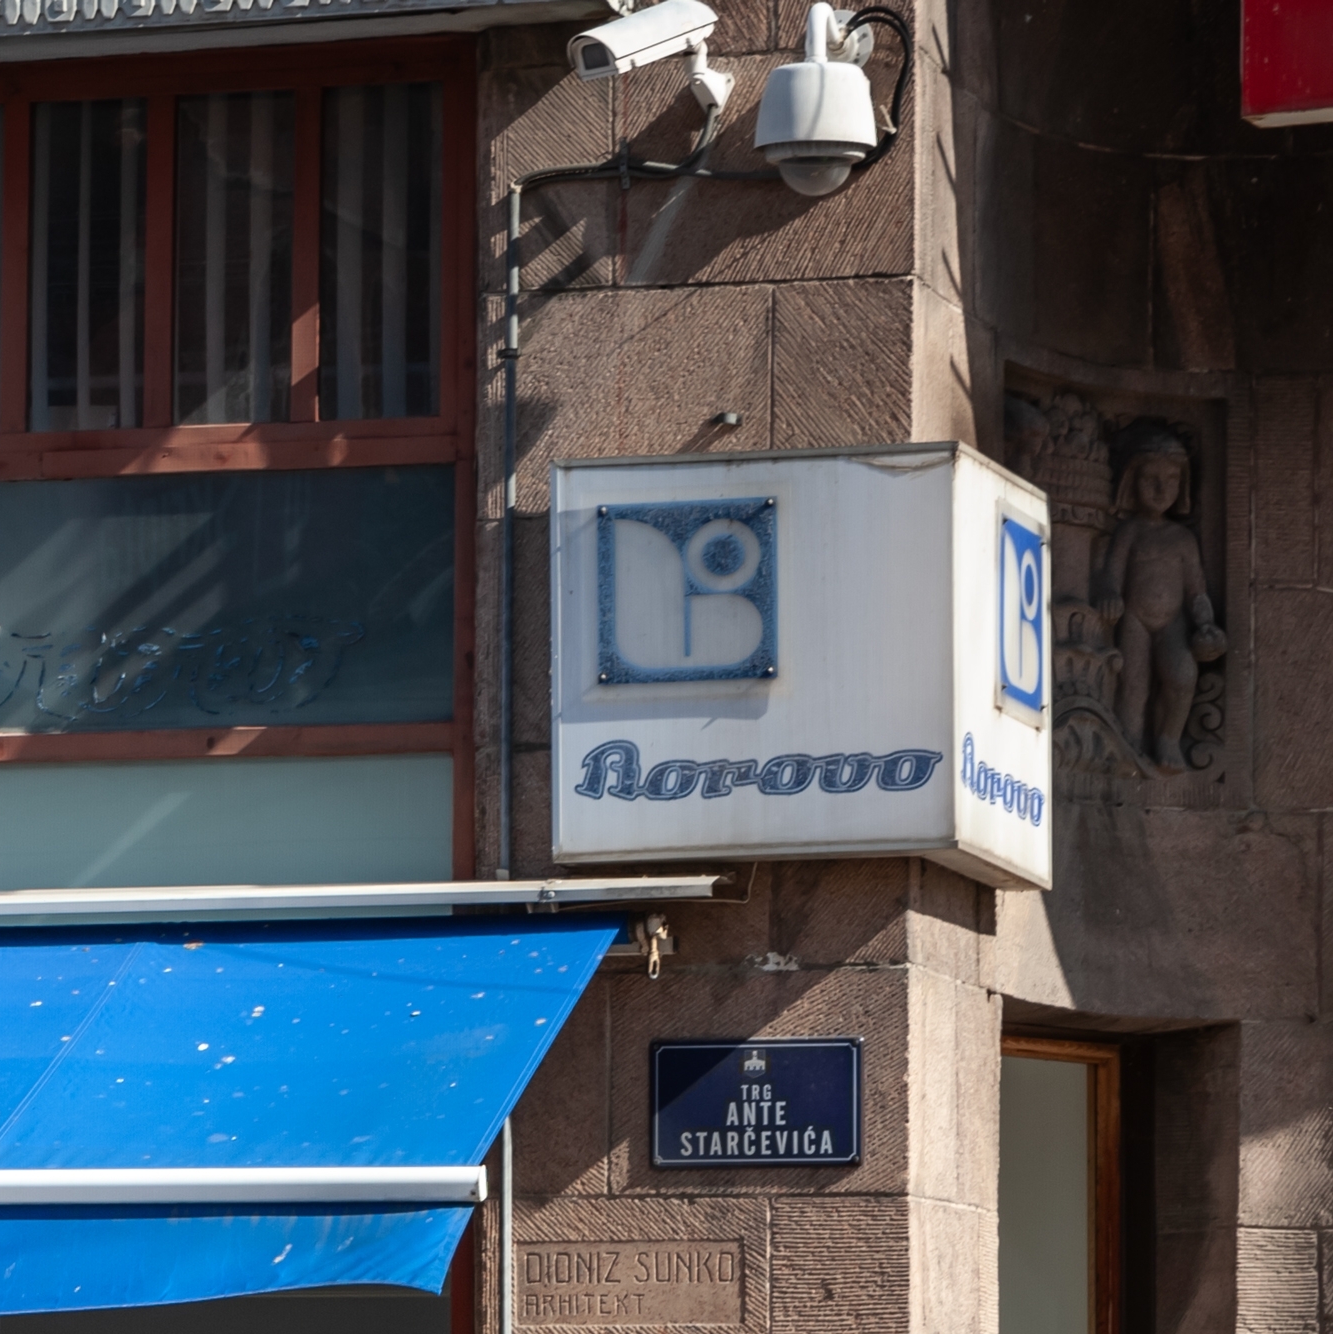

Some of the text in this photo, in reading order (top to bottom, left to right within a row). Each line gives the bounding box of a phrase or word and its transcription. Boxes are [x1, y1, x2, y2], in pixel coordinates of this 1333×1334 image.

[575, 740, 943, 802] Borovo
[961, 732, 1045, 827] Borovo
[741, 1084, 772, 1100] TRG
[726, 1101, 787, 1126] ANTE
[679, 1126, 834, 1157] STARČEVIĆA
[524, 1251, 735, 1285] DIONIZ SUNKO
[523, 1291, 646, 1317] ARHITEKT
